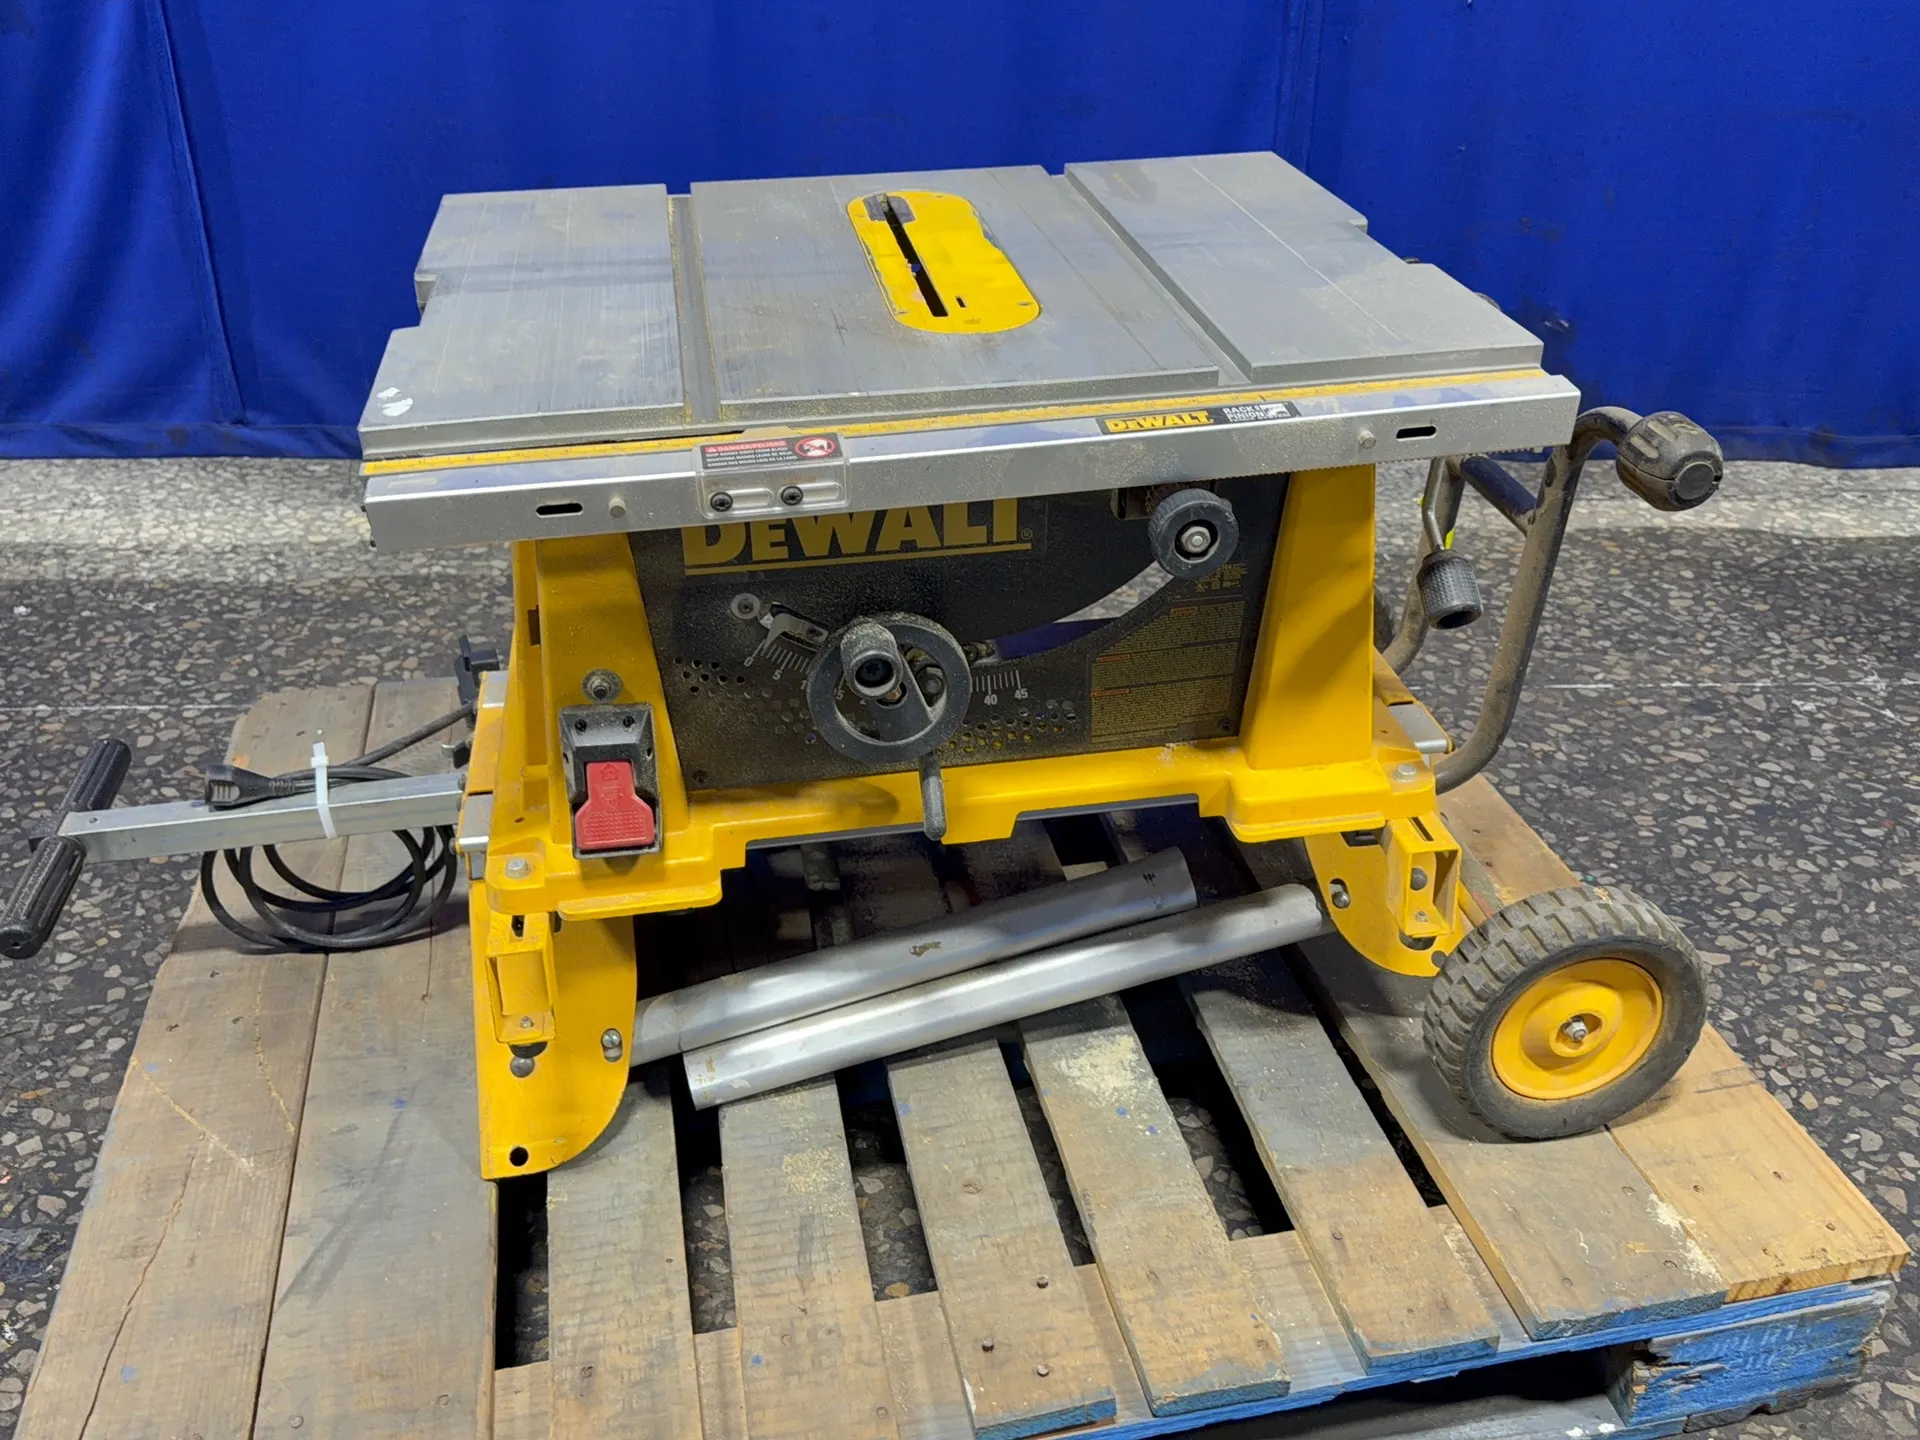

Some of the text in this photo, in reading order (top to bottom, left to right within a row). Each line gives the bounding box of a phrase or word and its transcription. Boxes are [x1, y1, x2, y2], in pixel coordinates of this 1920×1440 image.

[743, 656, 754, 667] 0
[772, 669, 783, 681] 5
[984, 693, 998, 706] 40
[1014, 687, 1029, 700] 45
